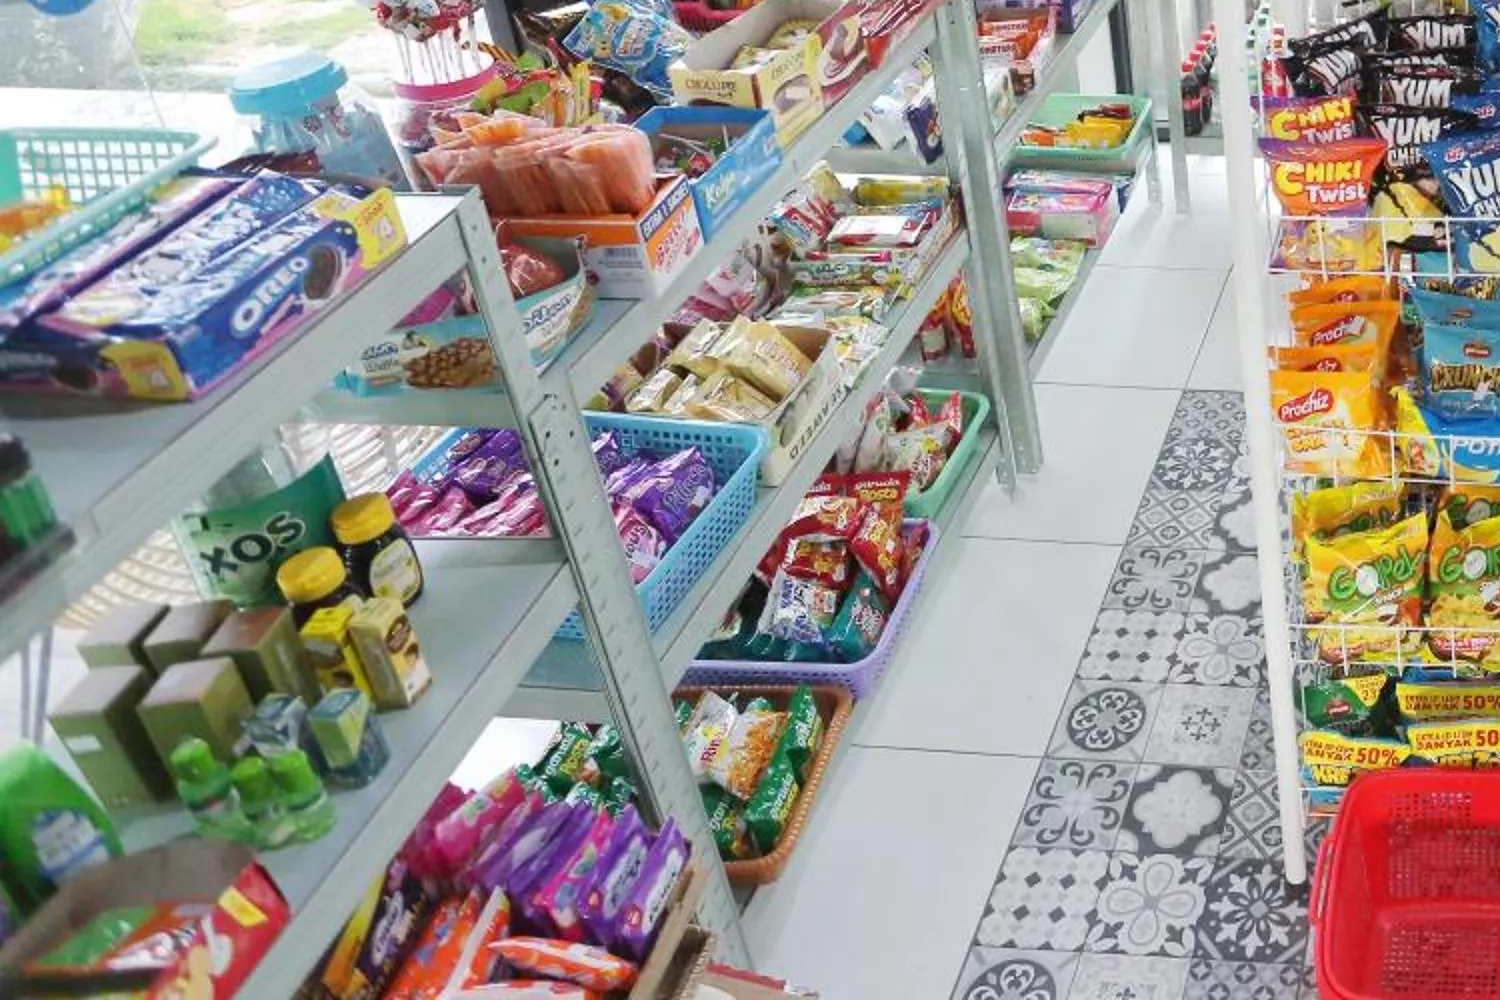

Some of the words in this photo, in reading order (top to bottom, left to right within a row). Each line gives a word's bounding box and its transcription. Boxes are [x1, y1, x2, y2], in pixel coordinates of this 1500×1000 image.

[1406, 19, 1467, 48] YUM
[1391, 78, 1454, 107] YUM
[1374, 114, 1441, 145] YUM
[1276, 159, 1361, 196] CHIKI
[233, 257, 311, 332] OREO
[1280, 388, 1330, 420] Prochiz
[1355, 747, 1401, 767] 50%
